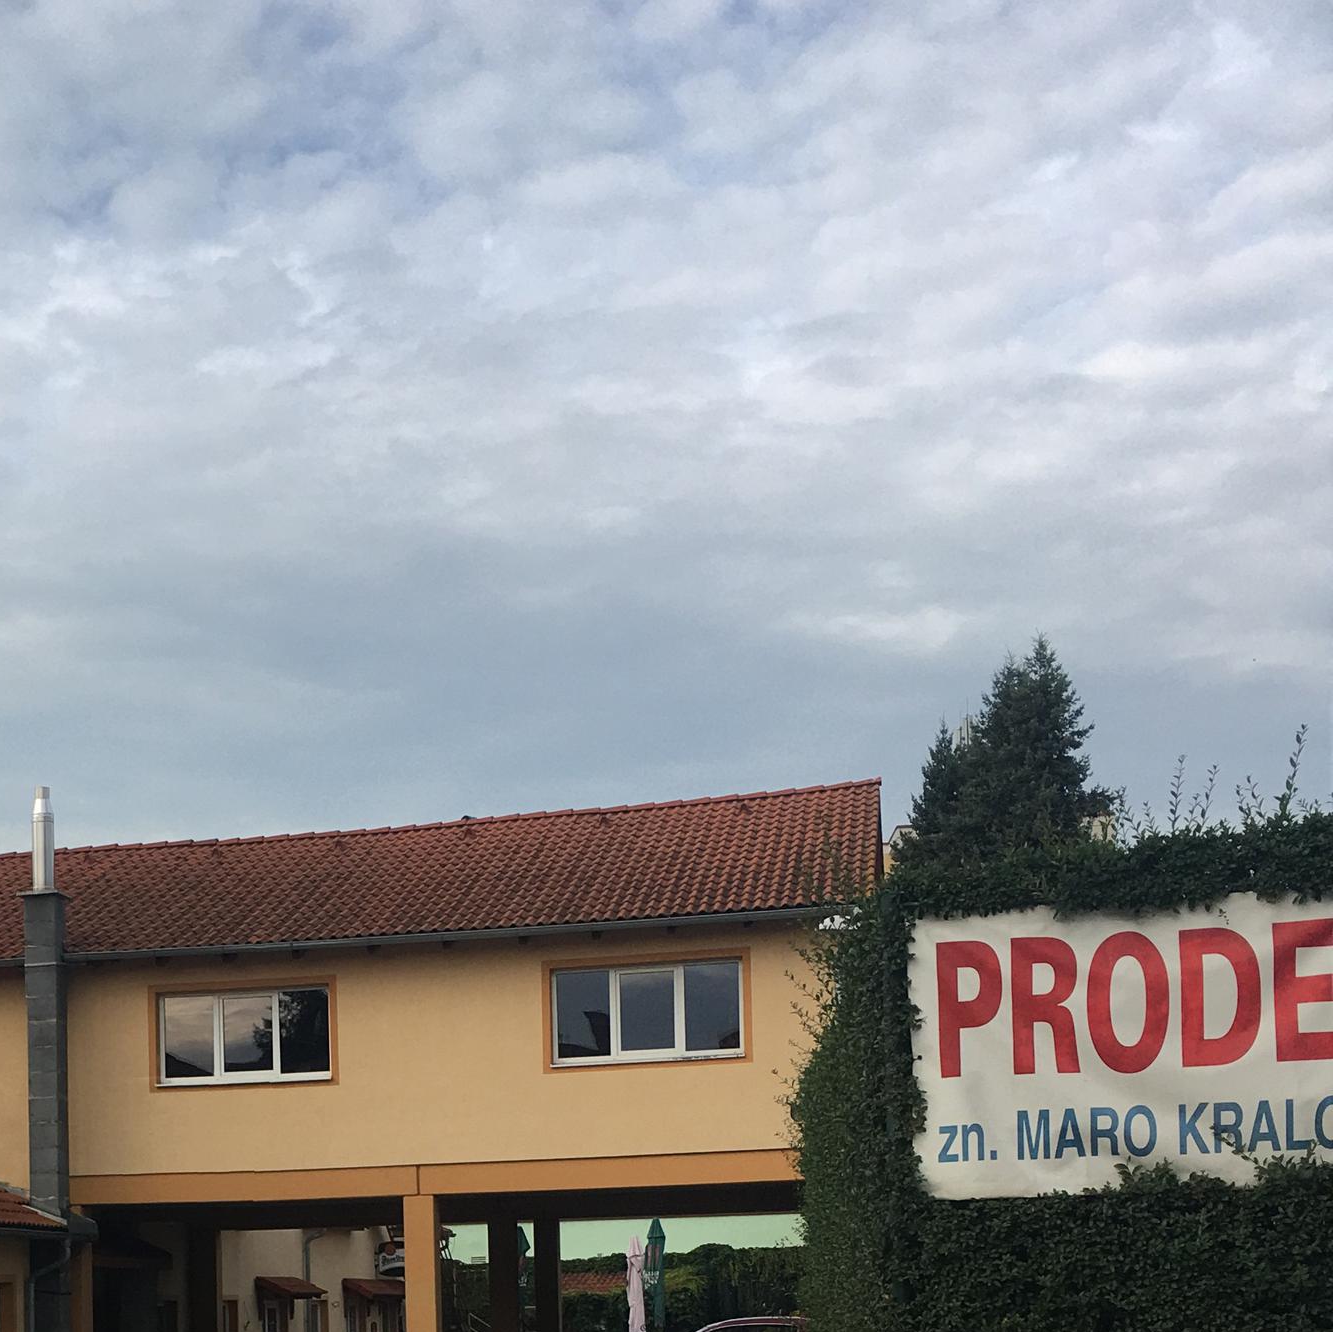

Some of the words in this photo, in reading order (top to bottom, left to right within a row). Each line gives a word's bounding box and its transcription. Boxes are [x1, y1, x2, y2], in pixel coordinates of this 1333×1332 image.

[936, 918, 1333, 1078] PRODE
[937, 1121, 998, 1164] zn.
[1017, 1104, 1158, 1161] MARO
